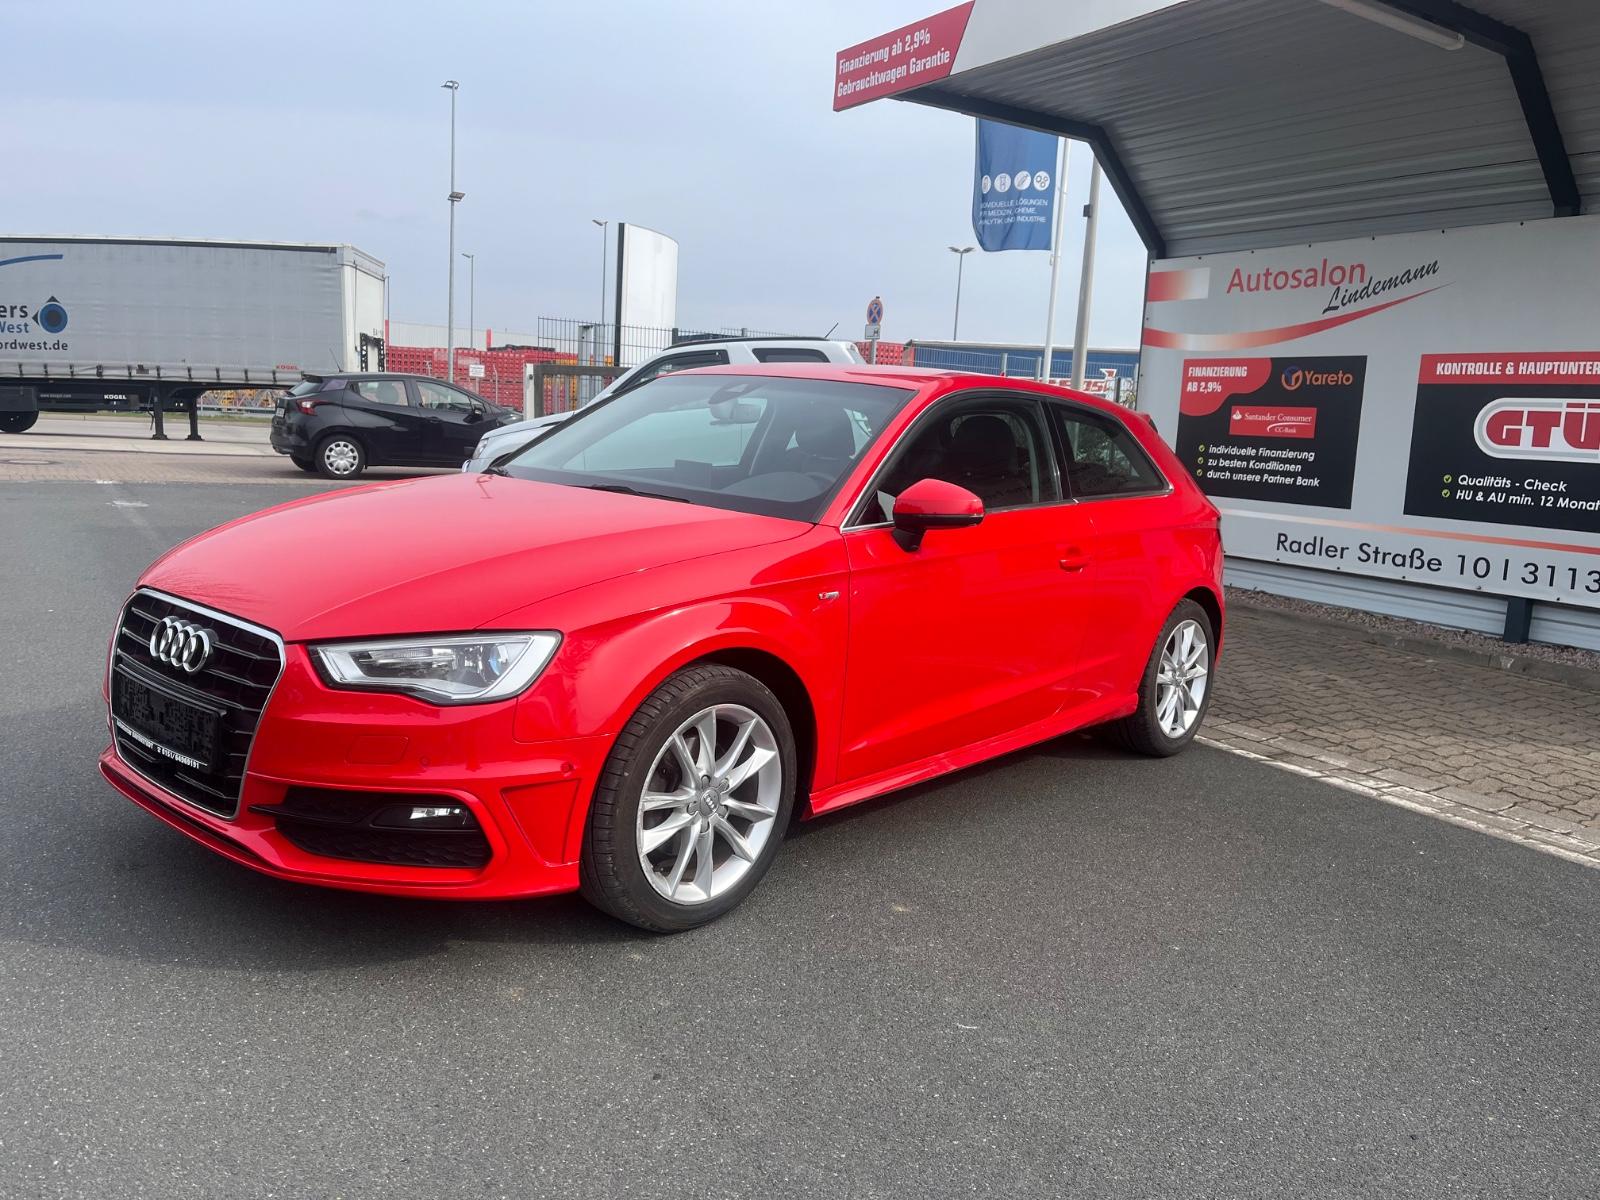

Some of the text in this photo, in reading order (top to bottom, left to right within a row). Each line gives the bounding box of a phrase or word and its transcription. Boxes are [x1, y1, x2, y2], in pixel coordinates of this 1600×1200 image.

[839, 28, 930, 75] Finanzierung ab 2,9%
[837, 48, 950, 97] Gebrauchtwagen Garantie
[1226, 258, 1366, 294] Autosalon
[1322, 260, 1440, 315] Lindemann
[1188, 366, 1248, 377] FINANZIERUNG
[1436, 361, 1600, 375] KONTROLLE & HAUPTUNTER
[1305, 370, 1353, 386] Yareto
[1186, 382, 1222, 393] AB 2,9%
[1245, 412, 1312, 422] Santander Consumer
[1208, 444, 1315, 461] individuelle Finanzierung
[1219, 458, 1247, 468] besten
[1249, 460, 1302, 472] Konditionen
[1206, 469, 1320, 487] durch unsere Partner Bank
[1458, 474, 1511, 488] Qualitäts
[1524, 478, 1567, 492] Check
[1456, 489, 1473, 501] HU
[1475, 491, 1484, 502] &
[1487, 492, 1506, 503] AU
[1508, 493, 1534, 506] min.
[1540, 495, 1553, 508] 12
[1276, 532, 1349, 559] Radler
[1357, 542, 1443, 573] Straße
[1457, 554, 1491, 578] 10
[1521, 562, 1600, 593] 3113
